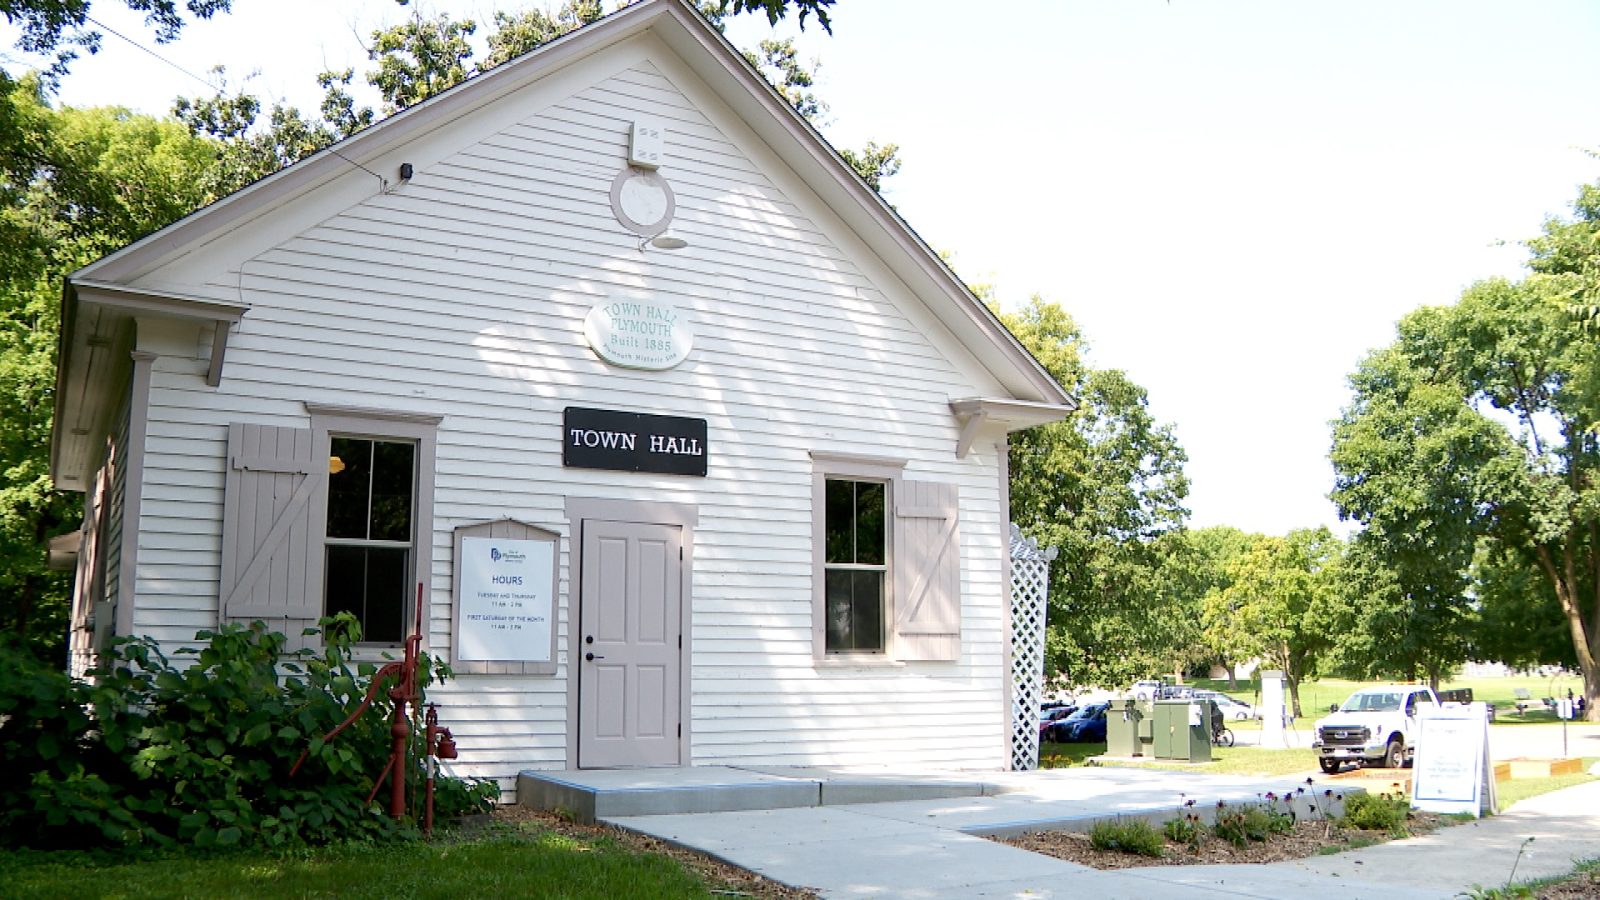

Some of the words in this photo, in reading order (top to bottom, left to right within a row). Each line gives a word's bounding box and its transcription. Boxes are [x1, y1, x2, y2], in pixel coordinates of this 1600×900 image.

[602, 302, 641, 317] TOWN
[646, 305, 677, 327] HALL
[611, 317, 672, 337] PLYMOUTH
[610, 333, 639, 348] Built
[645, 339, 671, 352] 1885
[635, 354, 663, 364] Historic
[570, 429, 637, 451] TOWN
[649, 434, 702, 456] HALL
[492, 575, 523, 586] HOURS
